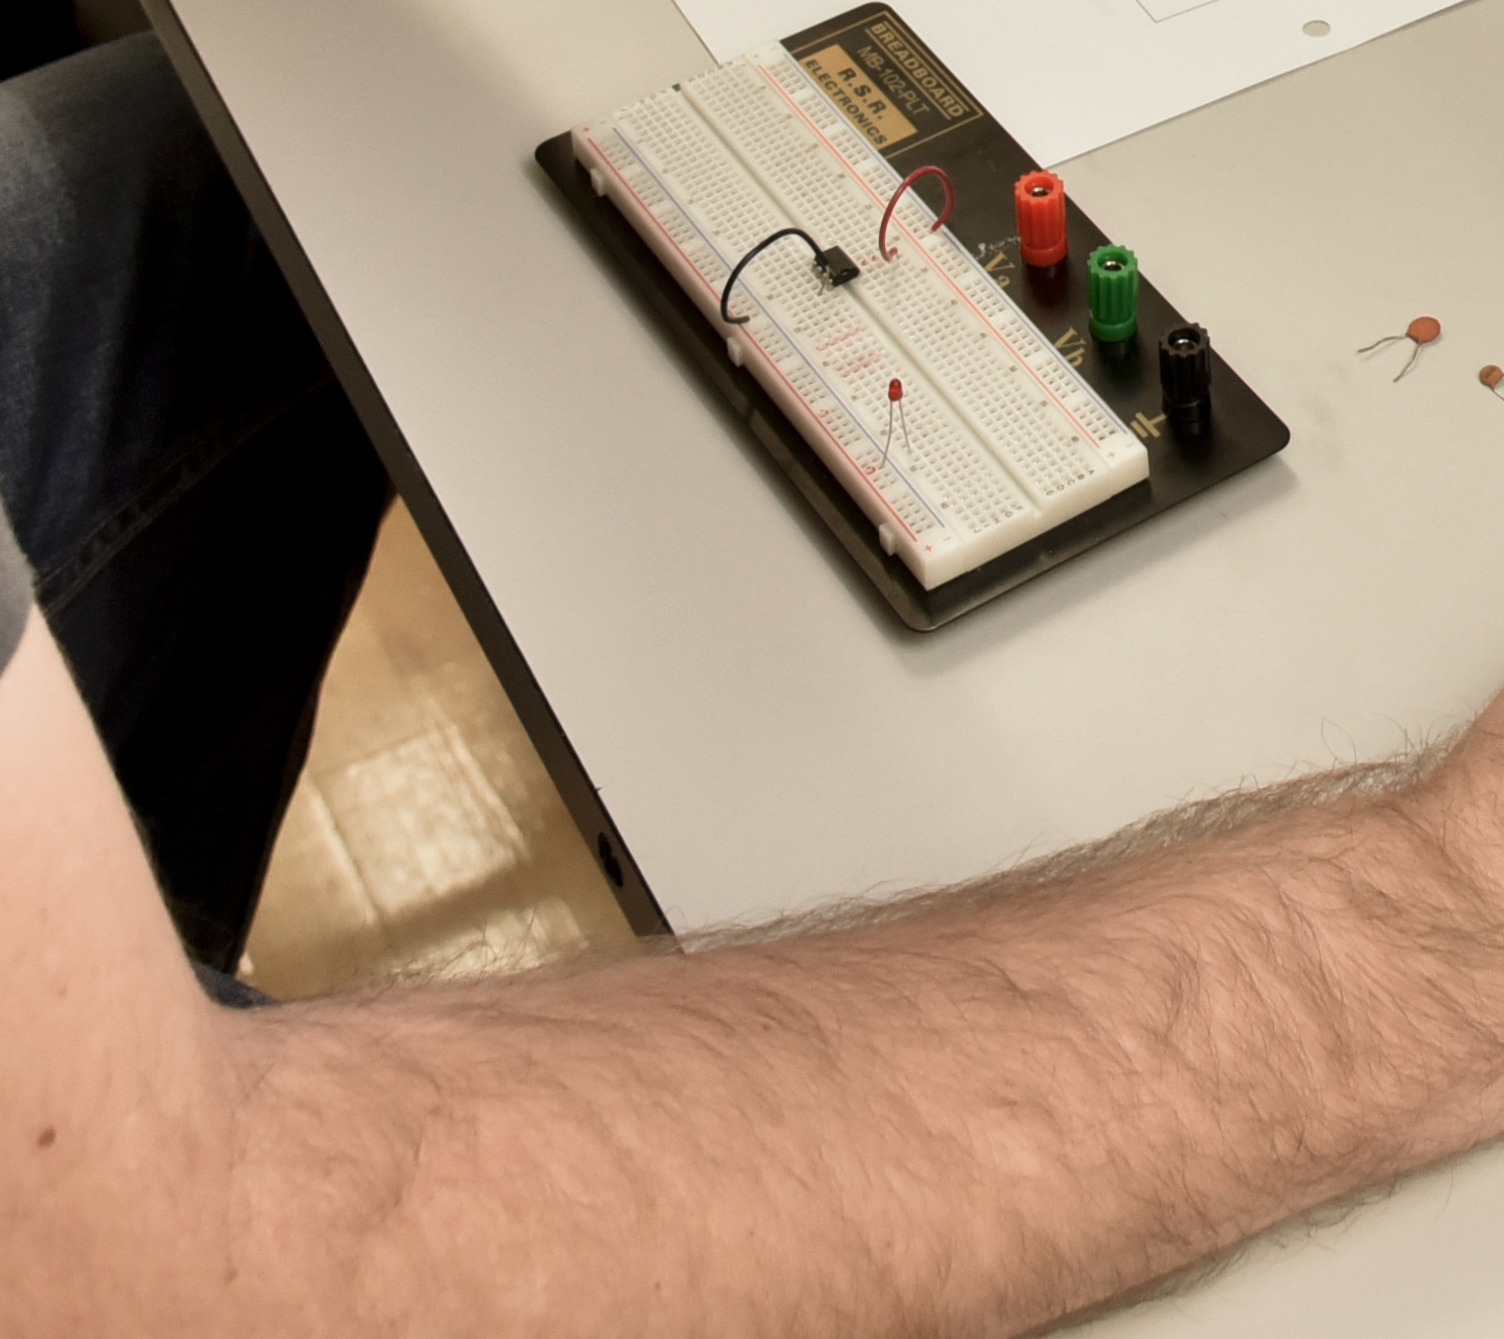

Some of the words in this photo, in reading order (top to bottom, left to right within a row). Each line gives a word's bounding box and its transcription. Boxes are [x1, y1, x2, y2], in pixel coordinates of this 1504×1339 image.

[806, 59, 887, 144] ELECTRONICS
[837, 67, 887, 120] R.S.R.
[857, 45, 930, 115] MB-102-PLT
[871, 23, 964, 117] BREADBOARD
